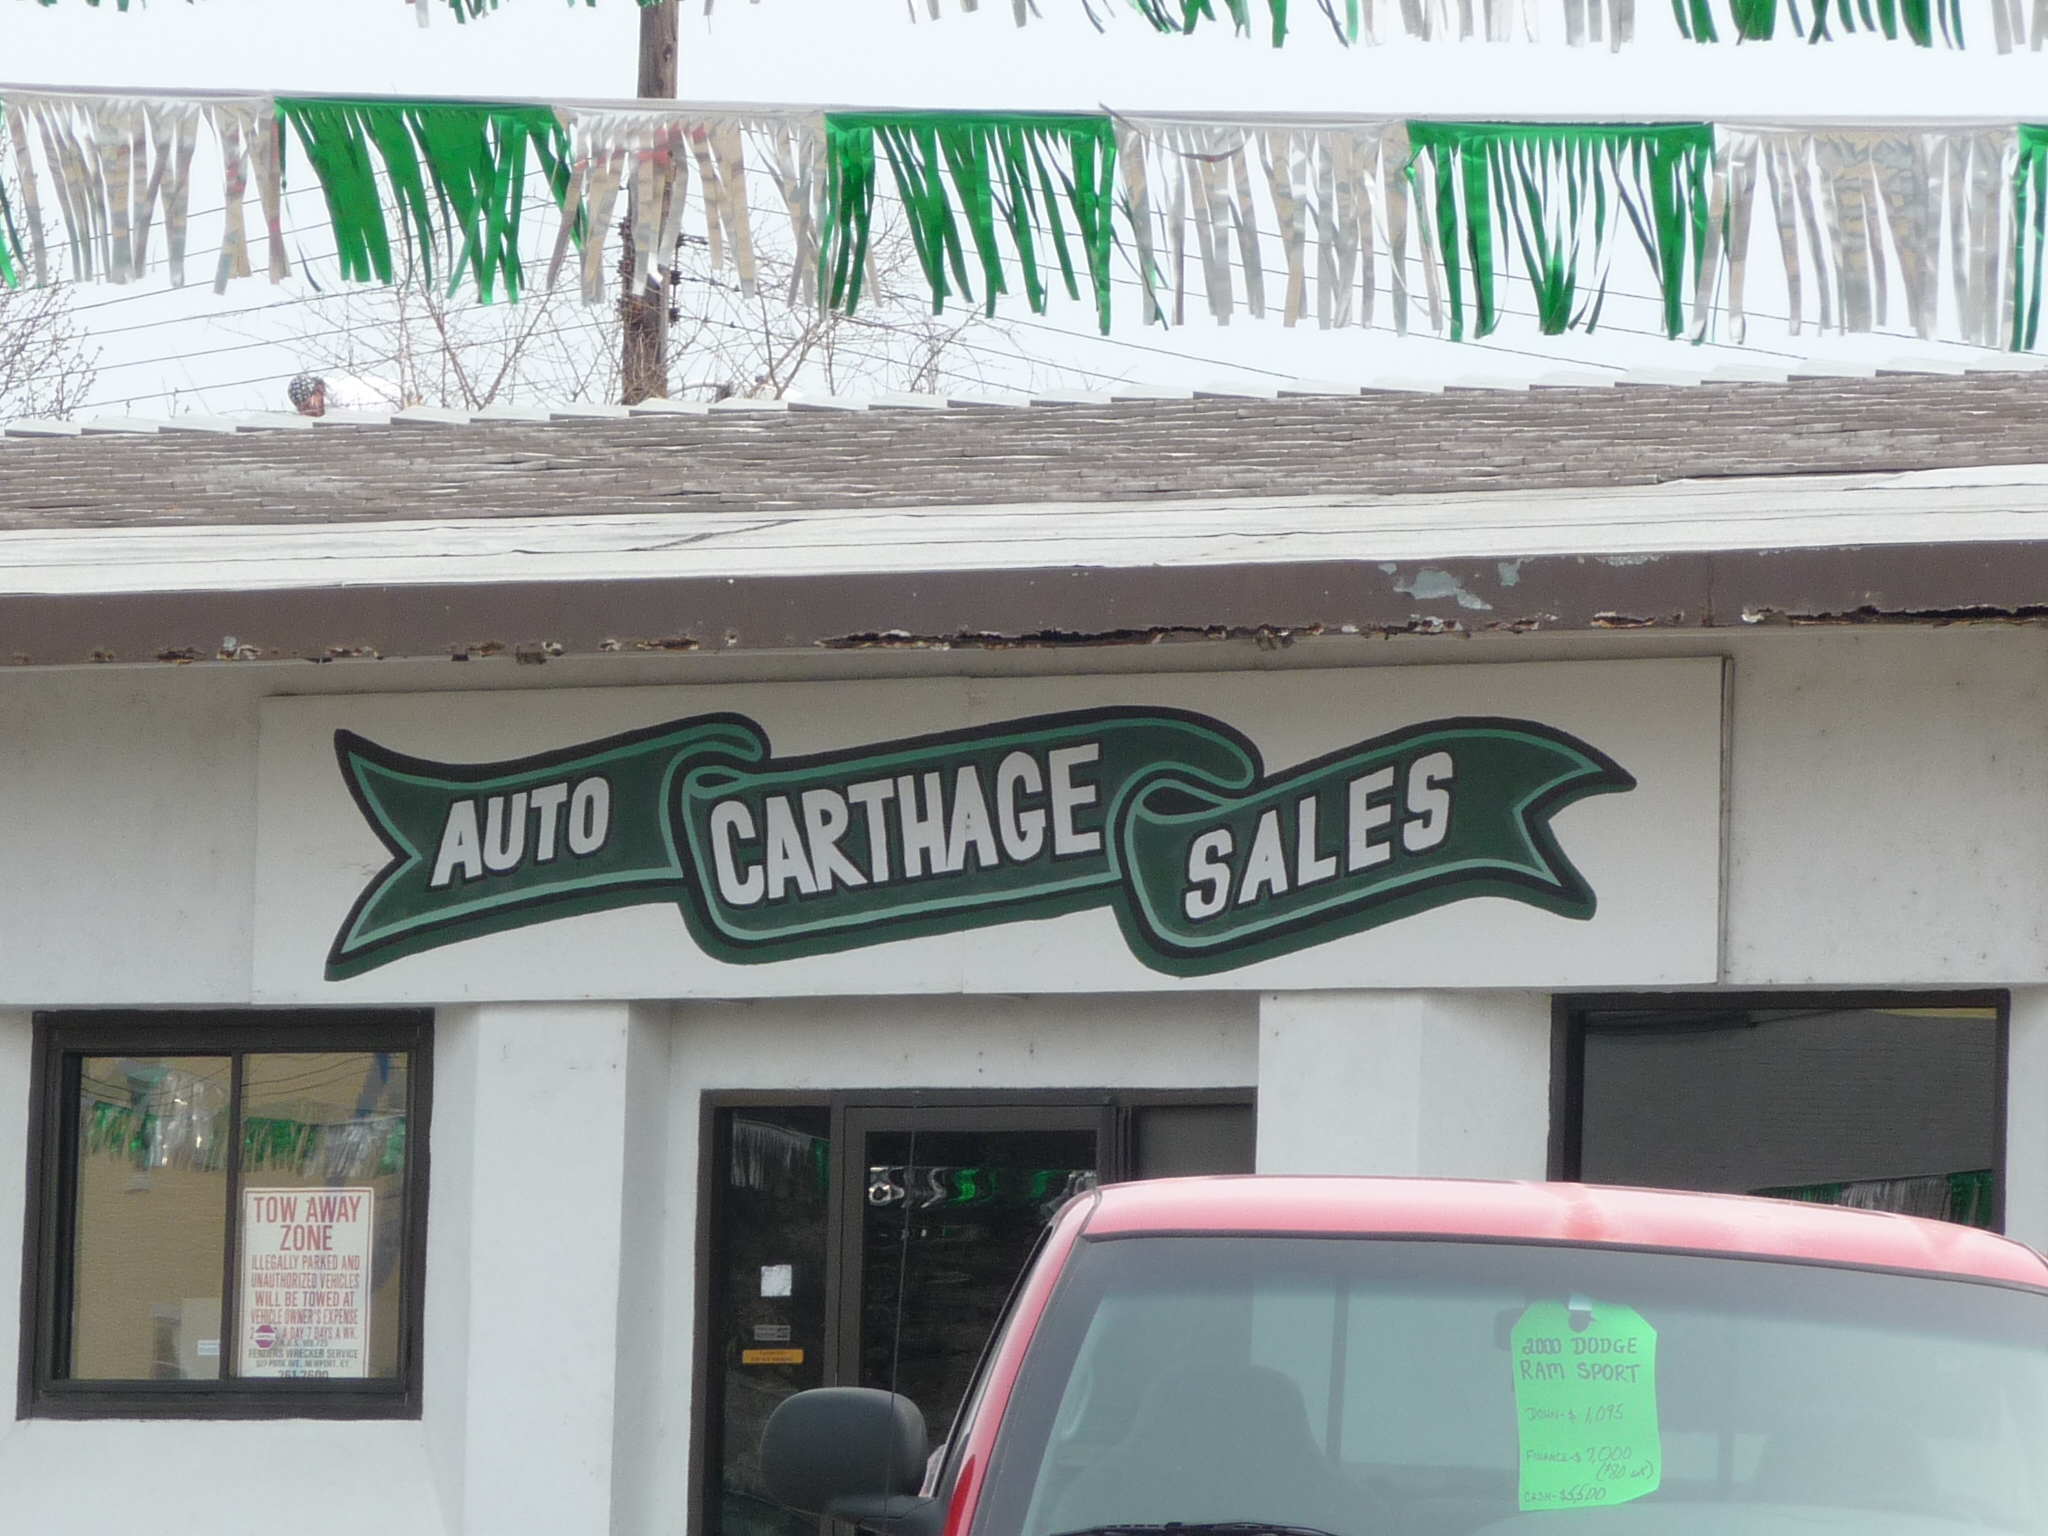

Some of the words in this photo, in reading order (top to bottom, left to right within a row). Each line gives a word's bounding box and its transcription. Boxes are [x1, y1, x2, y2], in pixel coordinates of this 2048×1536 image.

[430, 777, 610, 888] AUTO
[710, 743, 1100, 905] CARTHAGE
[1185, 751, 1454, 921] SALES
[253, 1197, 297, 1223] TOW
[305, 1196, 362, 1223] AWAY
[280, 1225, 333, 1251] ZONE
[252, 1254, 299, 1270] ILLEGALLY
[302, 1254, 338, 1271] PARKED
[341, 1254, 360, 1271] AND
[251, 1272, 317, 1289] UNAUTHORIZED
[320, 1273, 359, 1289] VEHICLES
[255, 1290, 281, 1307] WILL
[285, 1291, 299, 1307] BE
[302, 1291, 340, 1307] TOWED
[343, 1291, 355, 1307] AT
[250, 1308, 282, 1324] VEHICLE
[285, 1308, 321, 1324] OWNER'S
[323, 1308, 358, 1324] EXPENSE
[283, 1327, 288, 1340] A
[290, 1326, 305, 1340] DAY
[307, 1327, 312, 1340] 7
[314, 1326, 333, 1340] DAYS
[335, 1326, 342, 1340] A
[285, 1349, 325, 1358] WRECKER
[326, 1349, 358, 1358] SERVICE
[1522, 1337, 1562, 1355] 2000
[1570, 1337, 1637, 1354] DODGE
[1519, 1359, 1566, 1380] RAM
[1577, 1361, 1641, 1383] SPORT
